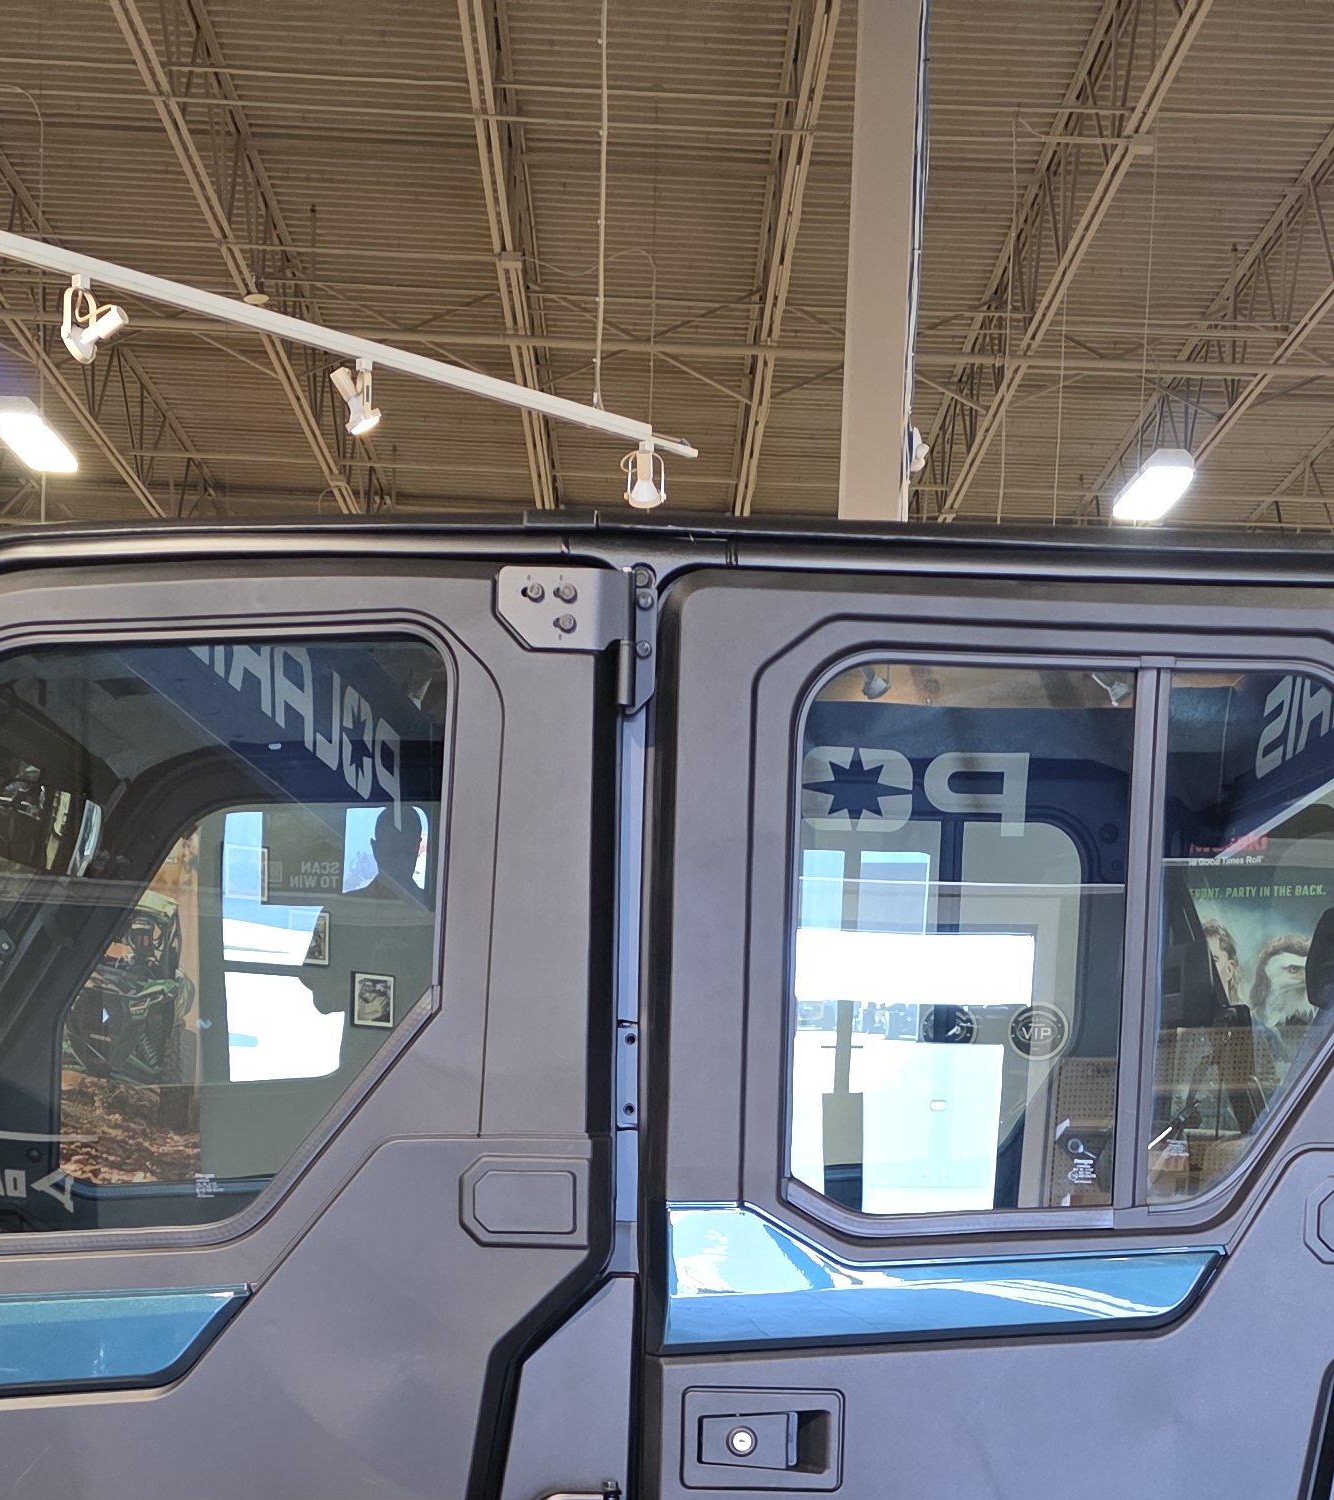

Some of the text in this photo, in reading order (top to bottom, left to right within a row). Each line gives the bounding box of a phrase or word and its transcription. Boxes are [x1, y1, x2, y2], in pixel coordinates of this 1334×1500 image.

[1225, 886, 1257, 898] PARTY
[1260, 886, 1270, 897] IN
[1274, 885, 1292, 896] THE
[1295, 884, 1327, 896] BACK.
[1021, 1026, 1052, 1040] VIP
